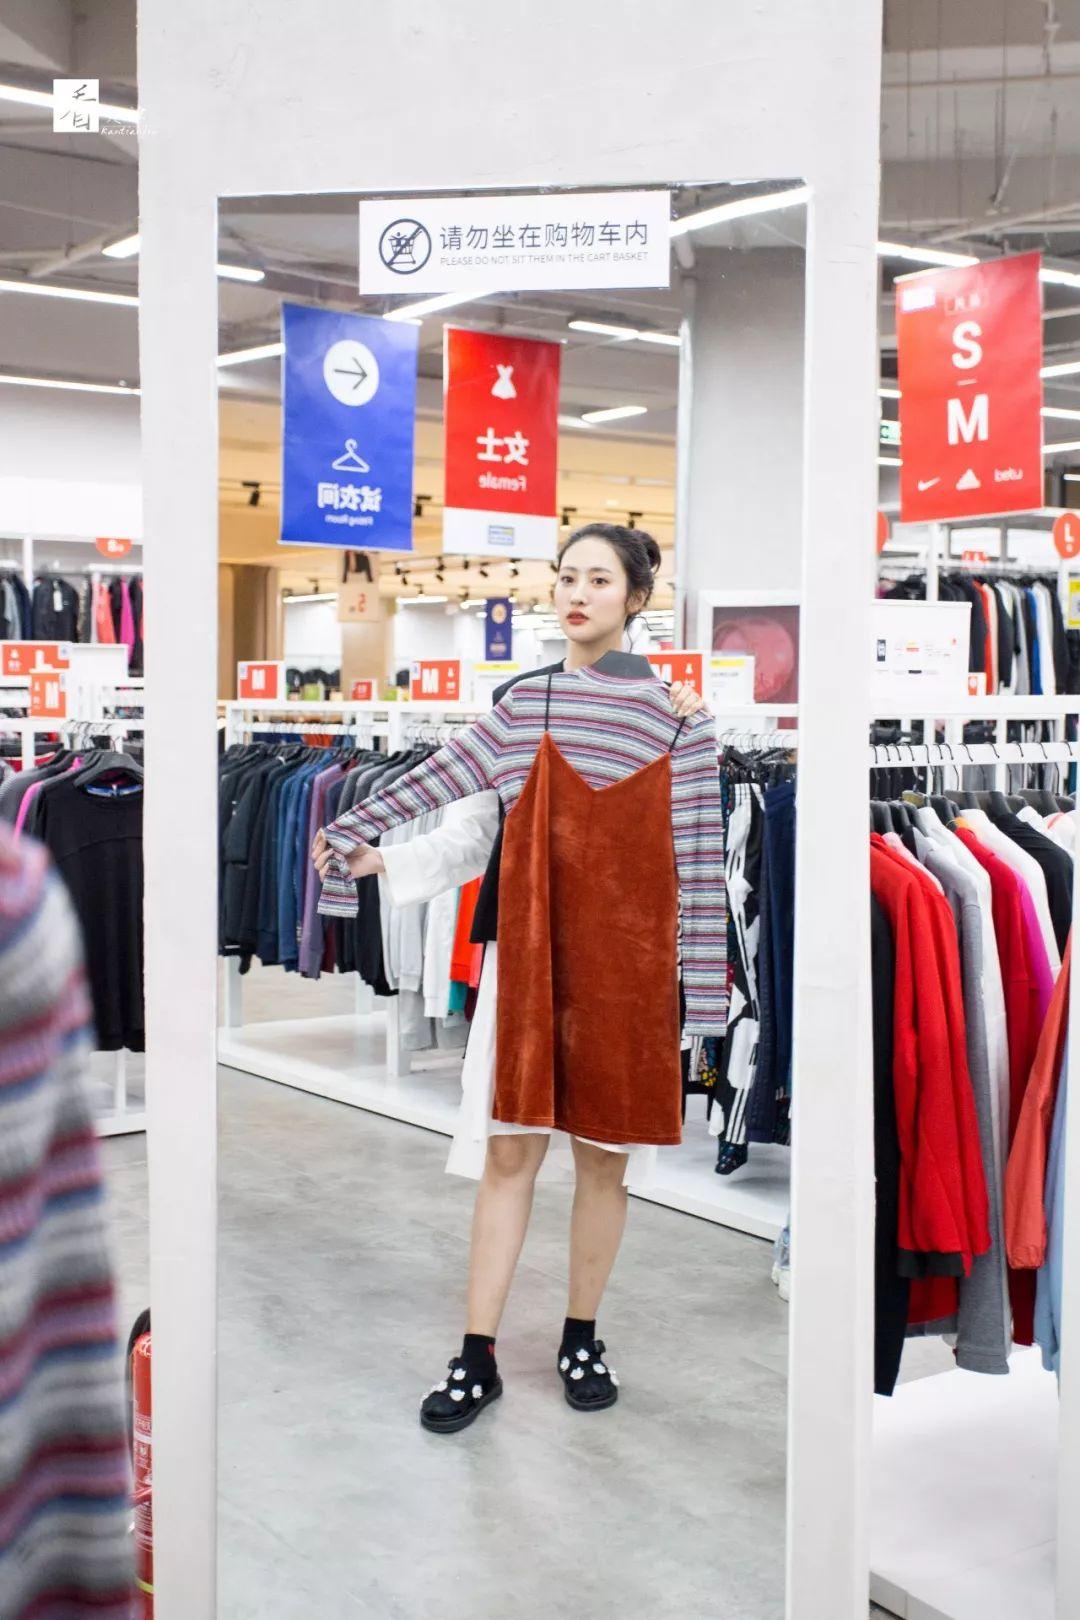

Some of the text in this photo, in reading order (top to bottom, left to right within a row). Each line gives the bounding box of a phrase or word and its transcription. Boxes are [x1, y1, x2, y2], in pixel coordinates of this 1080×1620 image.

[440, 219, 647, 250] 请勿坐在购物车内
[440, 251, 648, 266] PLEASE DO NOT SIT THEM IN THE CART BASKET
[952, 320, 983, 370] S
[947, 393, 989, 445] M
